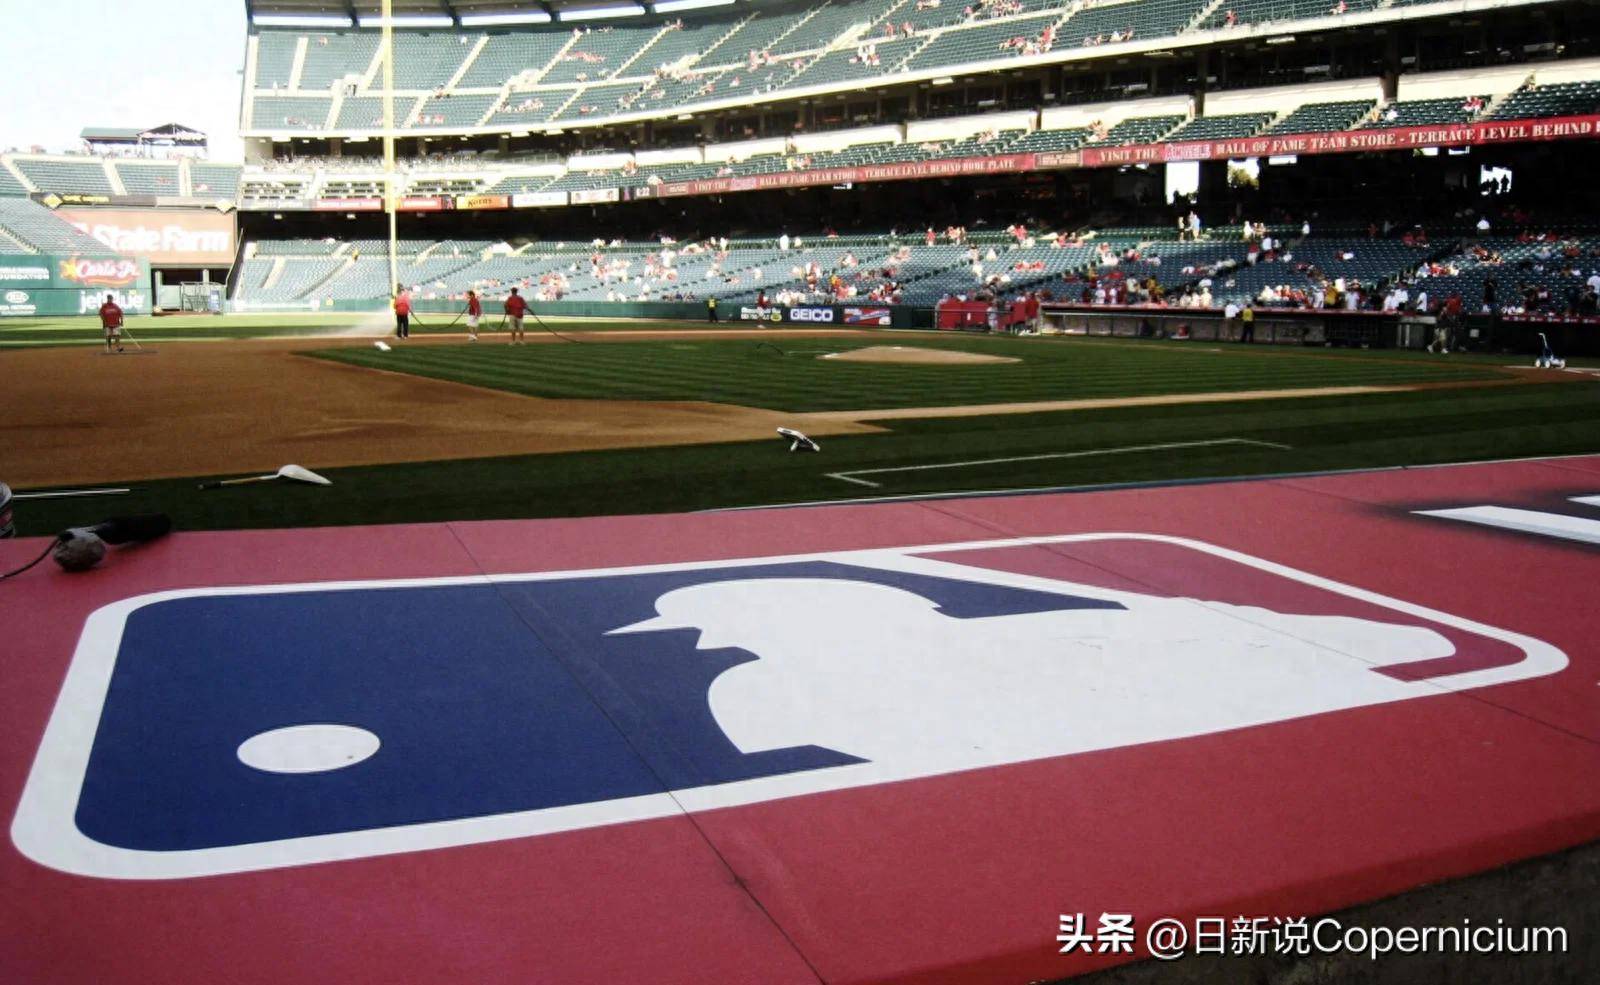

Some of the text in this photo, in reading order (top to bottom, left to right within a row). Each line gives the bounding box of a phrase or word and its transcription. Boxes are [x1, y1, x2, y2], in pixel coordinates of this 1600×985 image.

[1100, 150, 1130, 161] VISIT
[1135, 148, 1159, 160] THE
[1216, 142, 1249, 155] HALL
[1252, 141, 1270, 153] OF
[1273, 138, 1306, 151] FAME
[1311, 137, 1347, 150] TEAM
[1351, 133, 1396, 147] STORE
[1409, 128, 1475, 144] TERRACE
[1480, 126, 1528, 140] LEVEL
[1532, 122, 1592, 137] BEHIND
[811, 173, 832, 182] TEAM
[865, 168, 899, 179] TERRACE
[902, 166, 928, 176] LEVEL
[930, 163, 962, 174] BEHIND
[963, 161, 984, 172] HOME
[988, 159, 1015, 170] PLATE
[93, 224, 232, 252] State Farm
[790, 308, 833, 322] GEICO
